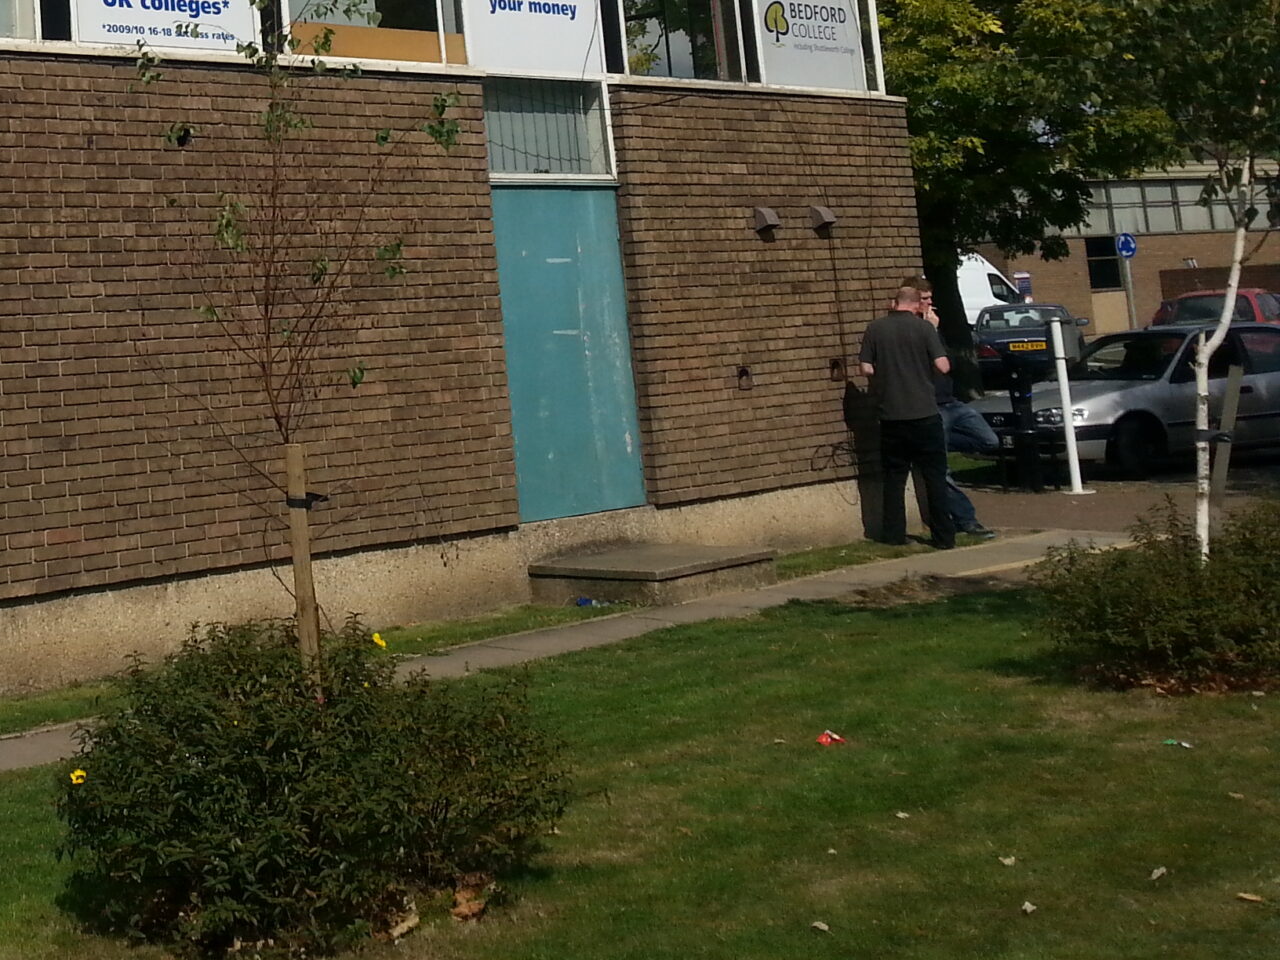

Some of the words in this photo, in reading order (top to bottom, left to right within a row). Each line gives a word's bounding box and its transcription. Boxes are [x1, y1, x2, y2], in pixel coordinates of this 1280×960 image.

[528, 0, 576, 21] money
[789, 2, 846, 23] BEDFORD
[148, 27, 172, 37] 16-18
[212, 31, 235, 41] rates
[791, 23, 837, 41] COLLEGE
